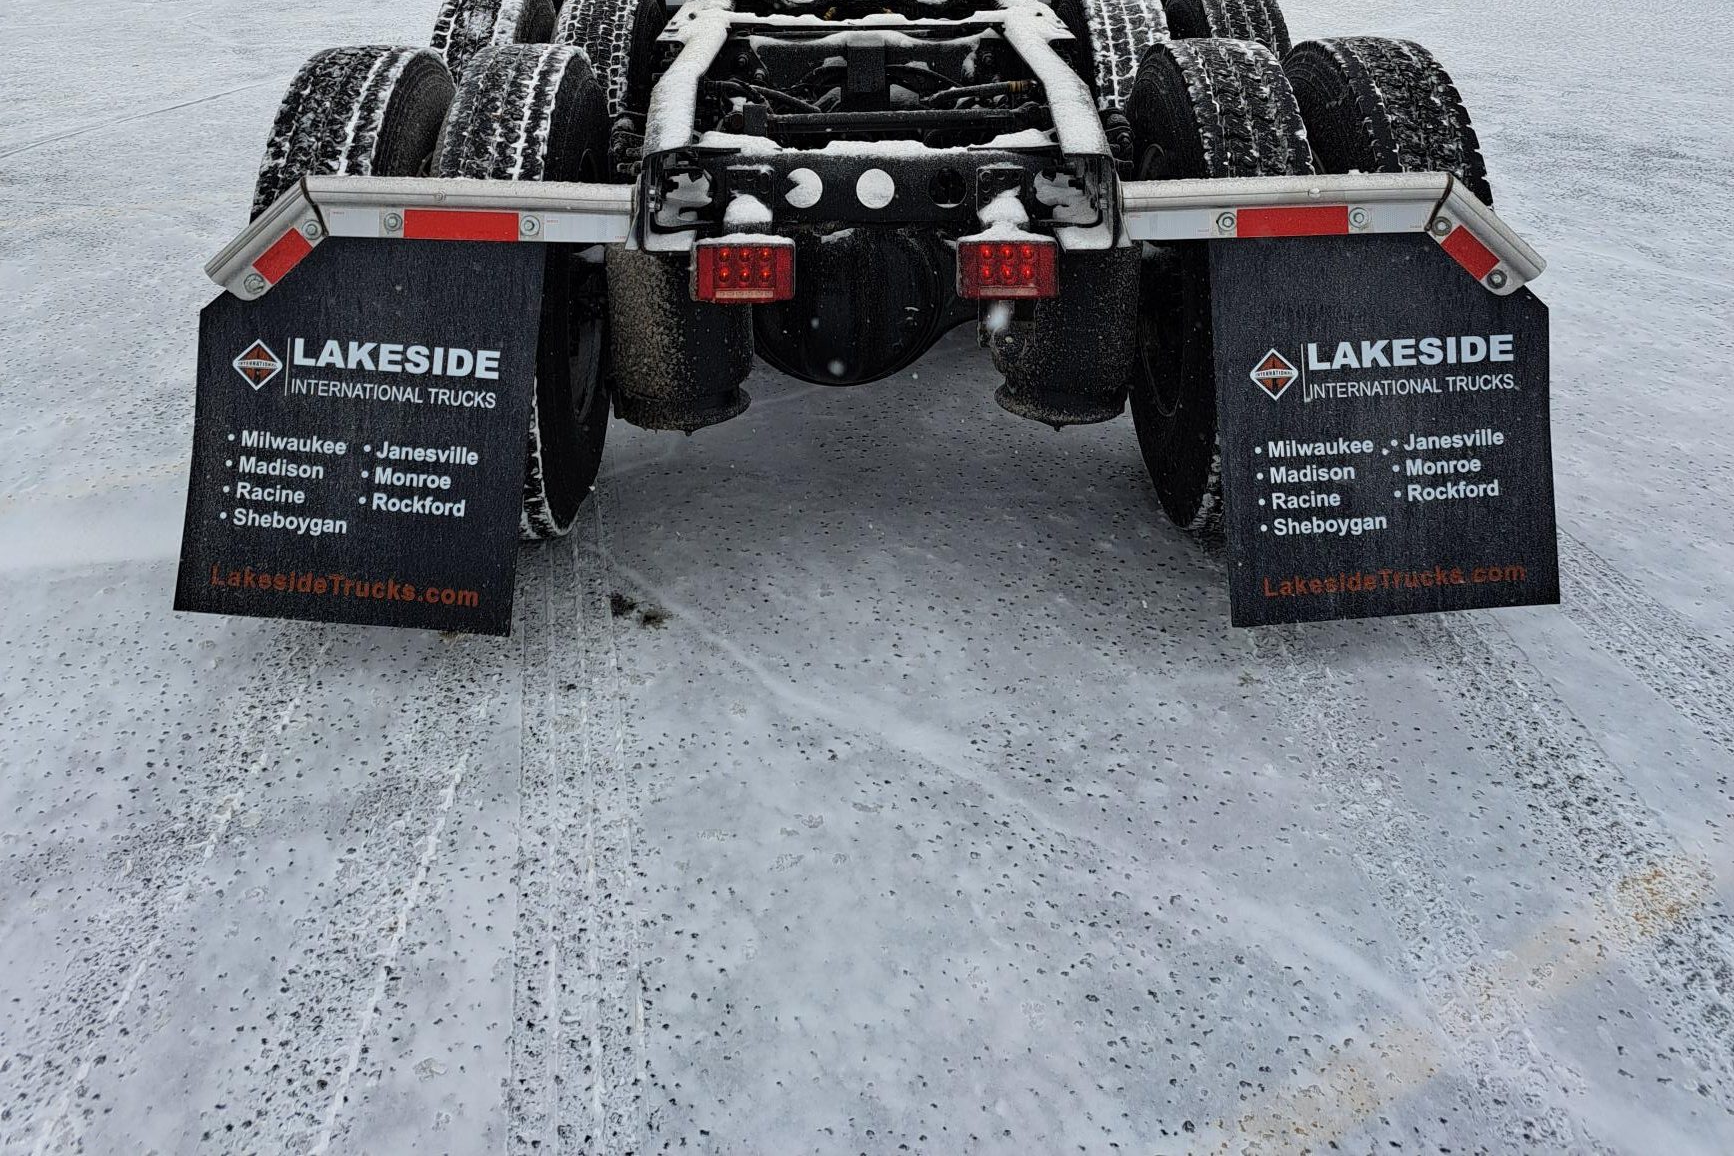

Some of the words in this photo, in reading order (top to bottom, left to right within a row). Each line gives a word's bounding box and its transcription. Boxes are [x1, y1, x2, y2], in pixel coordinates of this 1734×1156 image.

[293, 337, 501, 380] LAKESIDE
[1307, 334, 1514, 371] LAKESIDE
[291, 378, 424, 404] INTERNATIONAL
[427, 387, 496, 409] TRUCKS
[1309, 377, 1443, 400] INTERNATIONAL
[1445, 373, 1514, 392] TRUCKS
[241, 429, 347, 455] Milwaukee
[1267, 437, 1374, 458] Milwaukee
[1403, 428, 1505, 451] Janesville
[375, 441, 479, 466] Janesville
[238, 455, 324, 480] Madison
[374, 466, 452, 490] Monroe
[1269, 464, 1356, 484] Madison
[1405, 458, 1482, 477] Monroe
[236, 481, 306, 504] Racine
[1271, 490, 1341, 510] Racine
[1407, 479, 1499, 502] Rockford
[372, 492, 466, 518] Rockford
[232, 507, 347, 537] Sheboygan
[1273, 516, 1388, 537] Sheboygan
[211, 566, 480, 606] LakesideTrucks.com
[1263, 565, 1527, 597] LakesideTrucks.com
